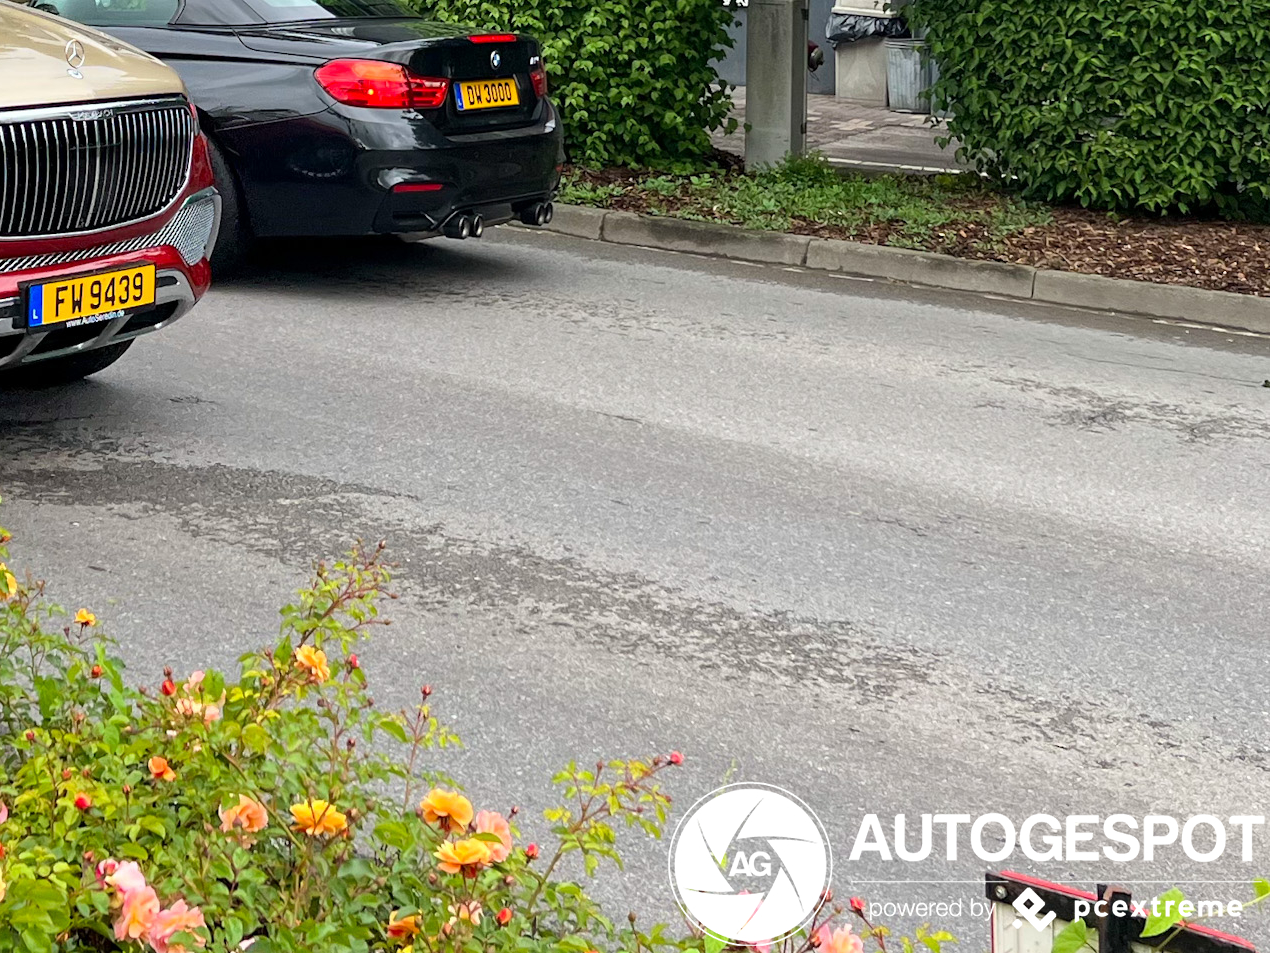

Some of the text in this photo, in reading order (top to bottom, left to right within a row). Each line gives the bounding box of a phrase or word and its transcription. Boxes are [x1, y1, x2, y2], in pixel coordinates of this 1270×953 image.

[466, 82, 512, 106] DW 3000
[55, 272, 143, 318] FW 9439
[32, 308, 39, 320] L
